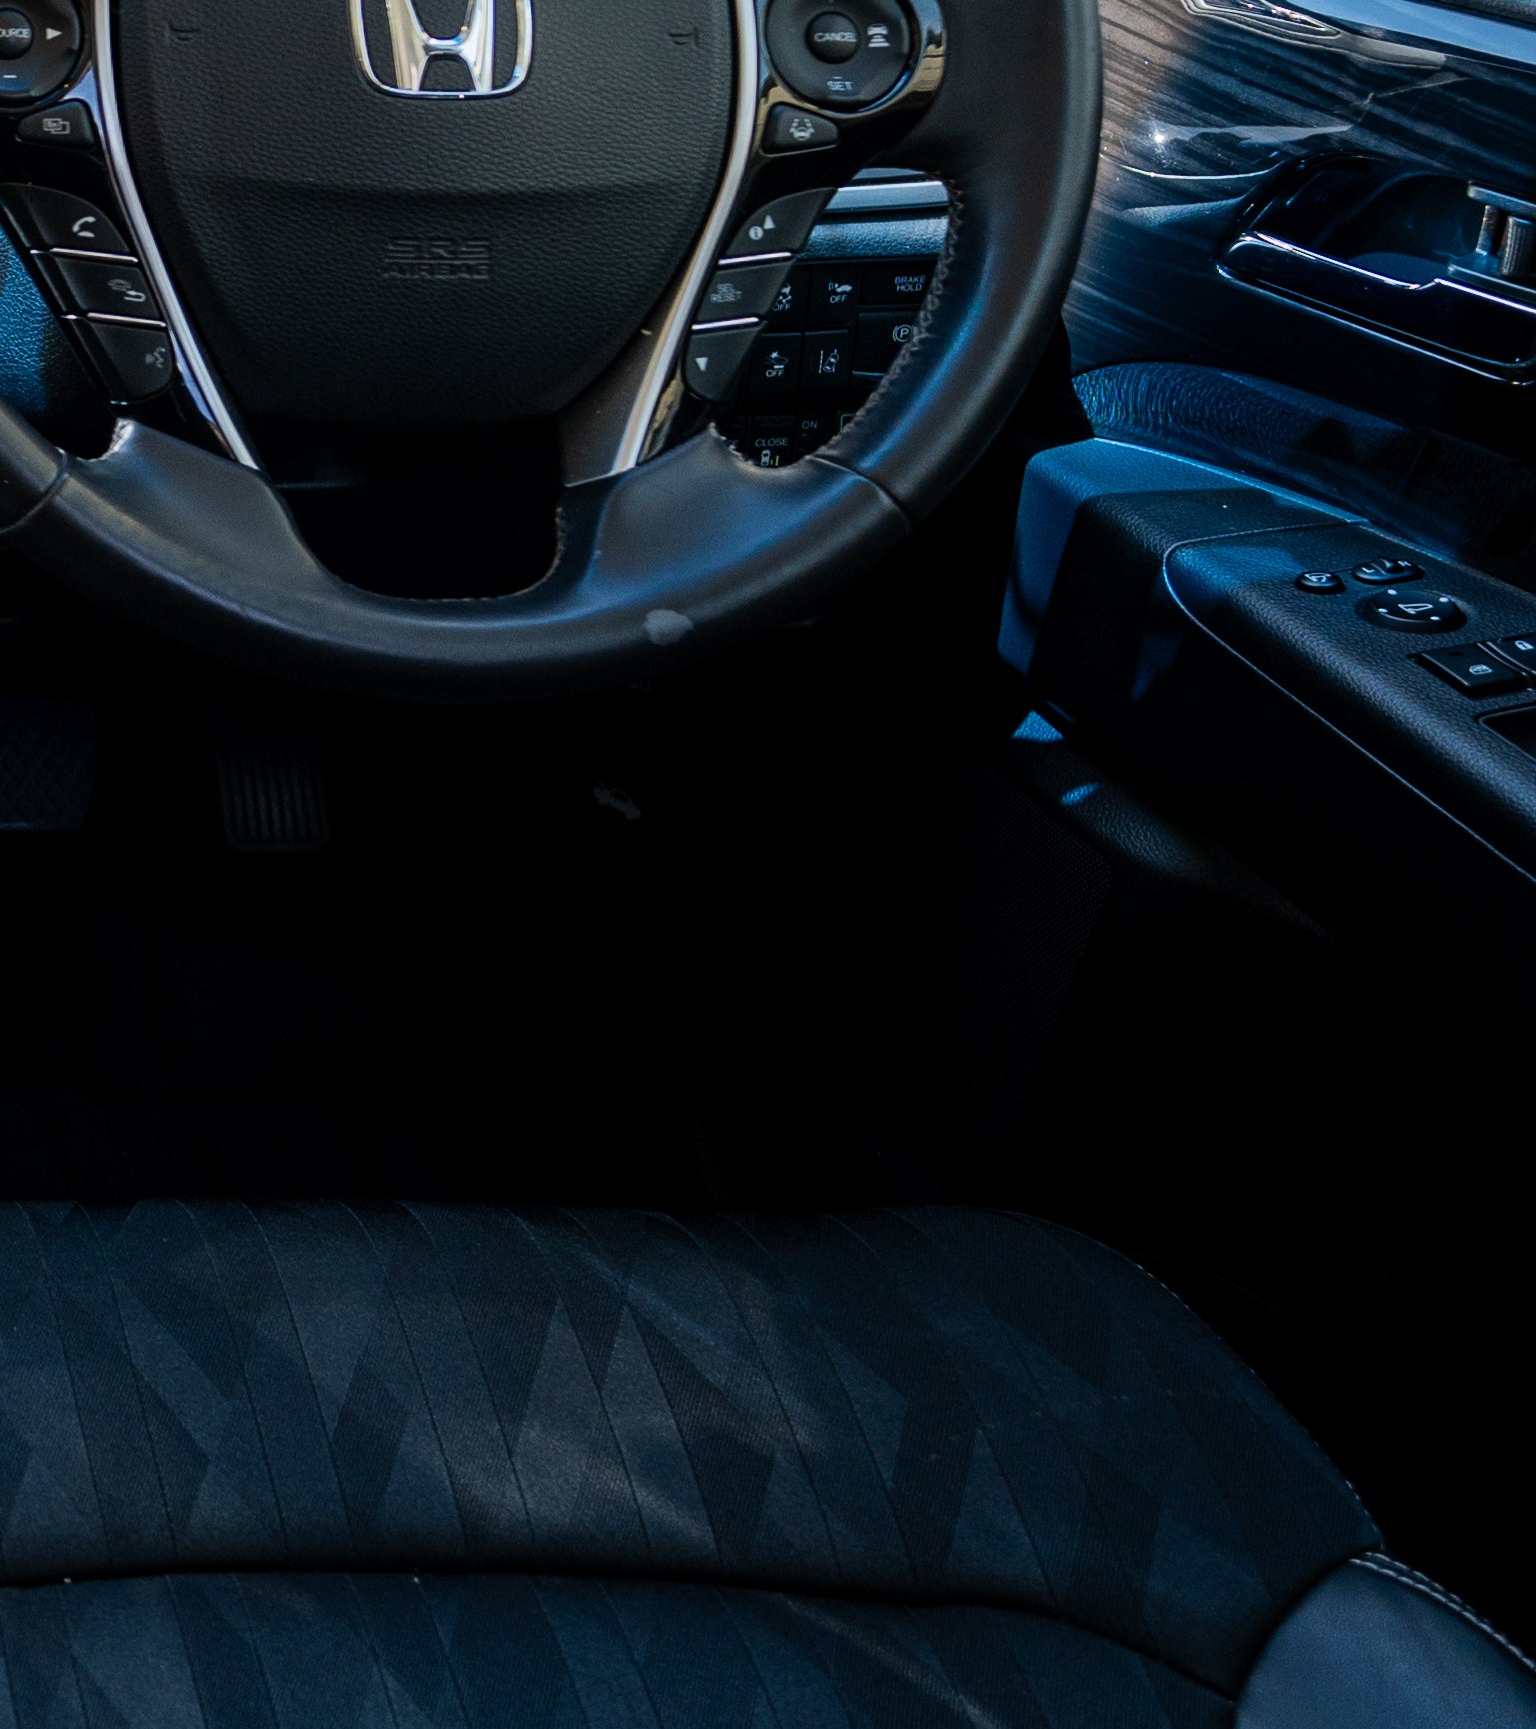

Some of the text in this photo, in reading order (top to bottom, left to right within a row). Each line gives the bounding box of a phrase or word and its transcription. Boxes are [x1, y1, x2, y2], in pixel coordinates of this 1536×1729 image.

[813, 31, 858, 43] CANCEL
[826, 80, 852, 91] SET
[894, 275, 926, 285] BRAKE
[896, 283, 923, 292] HOLD
[830, 294, 848, 304] OFF
[765, 369, 785, 378] OFF
[755, 437, 789, 447] CLOSE
